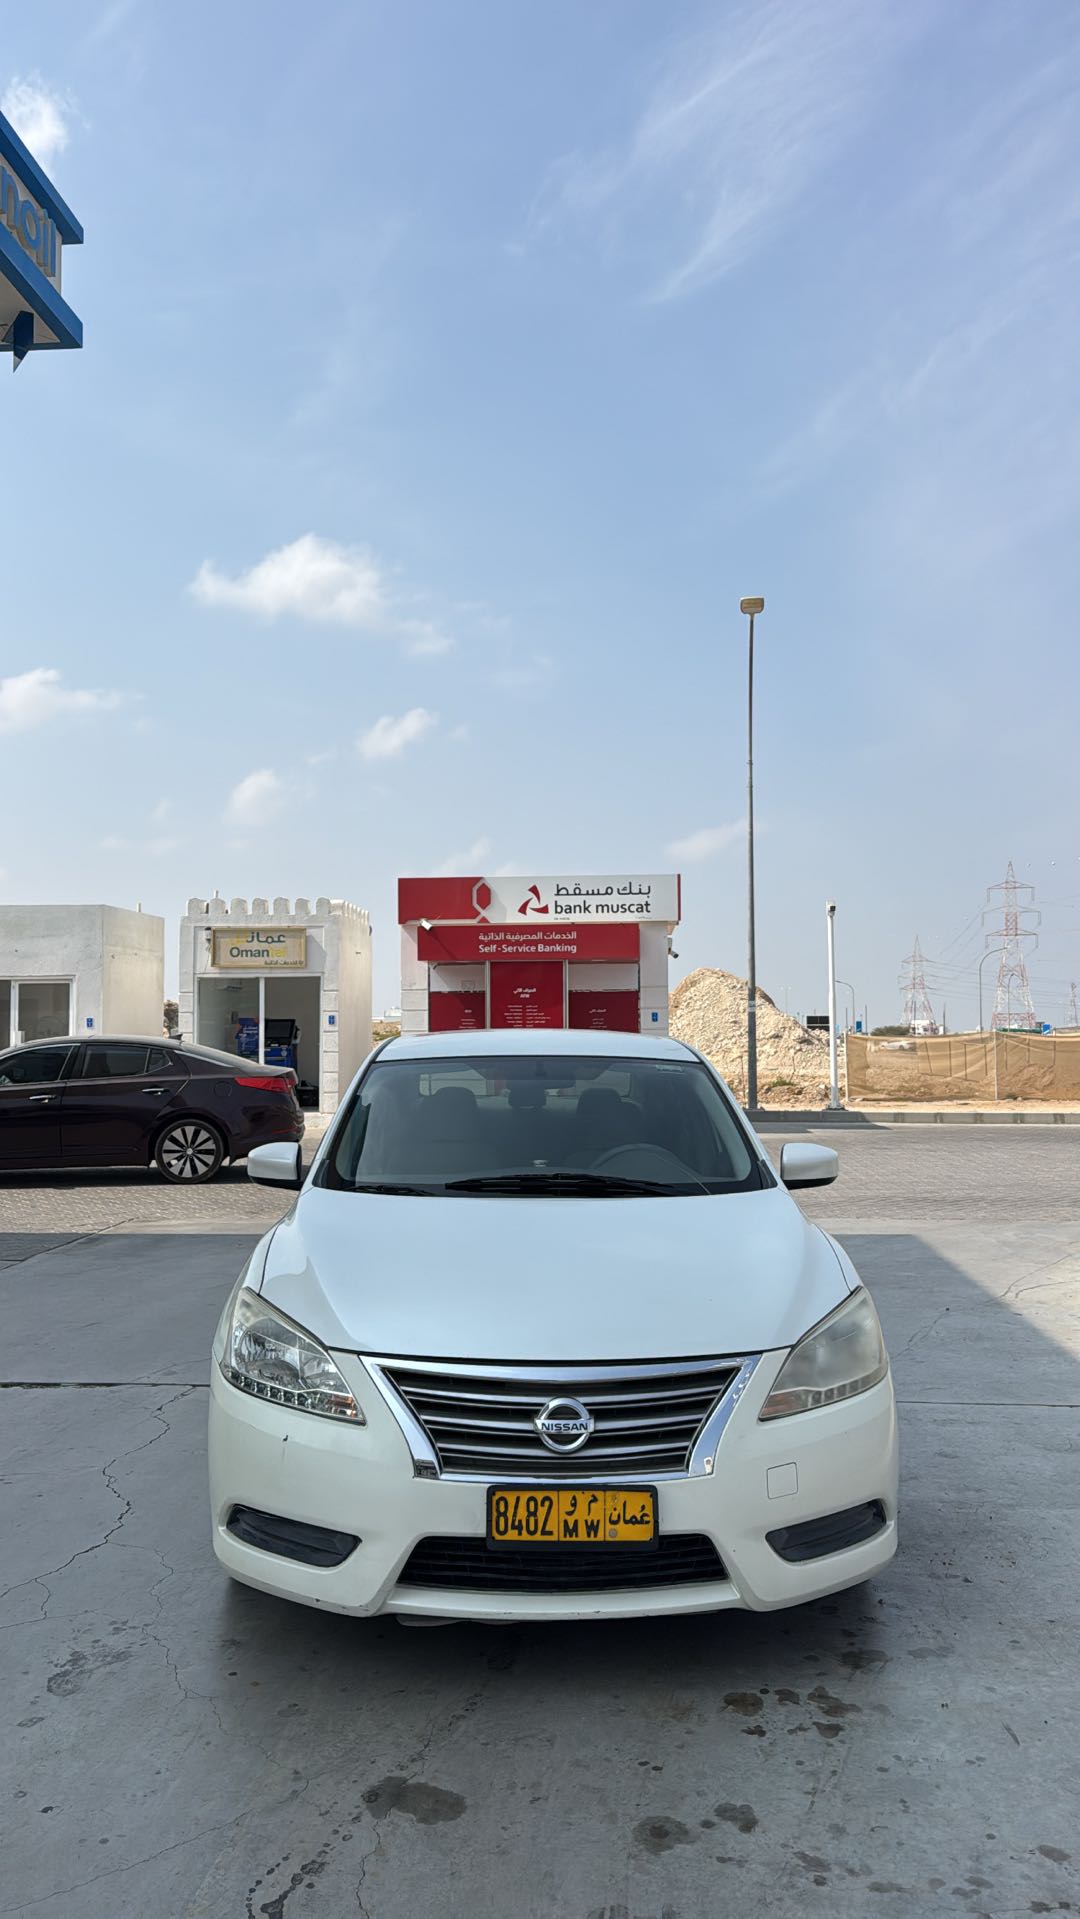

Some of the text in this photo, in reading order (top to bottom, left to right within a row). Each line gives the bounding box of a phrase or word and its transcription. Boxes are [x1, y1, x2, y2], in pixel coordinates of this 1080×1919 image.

[554, 881, 651, 898] بنك مسقط
[554, 900, 651, 914] bank muscat
[505, 931, 543, 942] المصرفية
[543, 931, 577, 940] الخدمات
[537, 943, 577, 954] Banking
[541, 1422, 588, 1431] NISSAN
[495, 1495, 554, 1537] 8482
